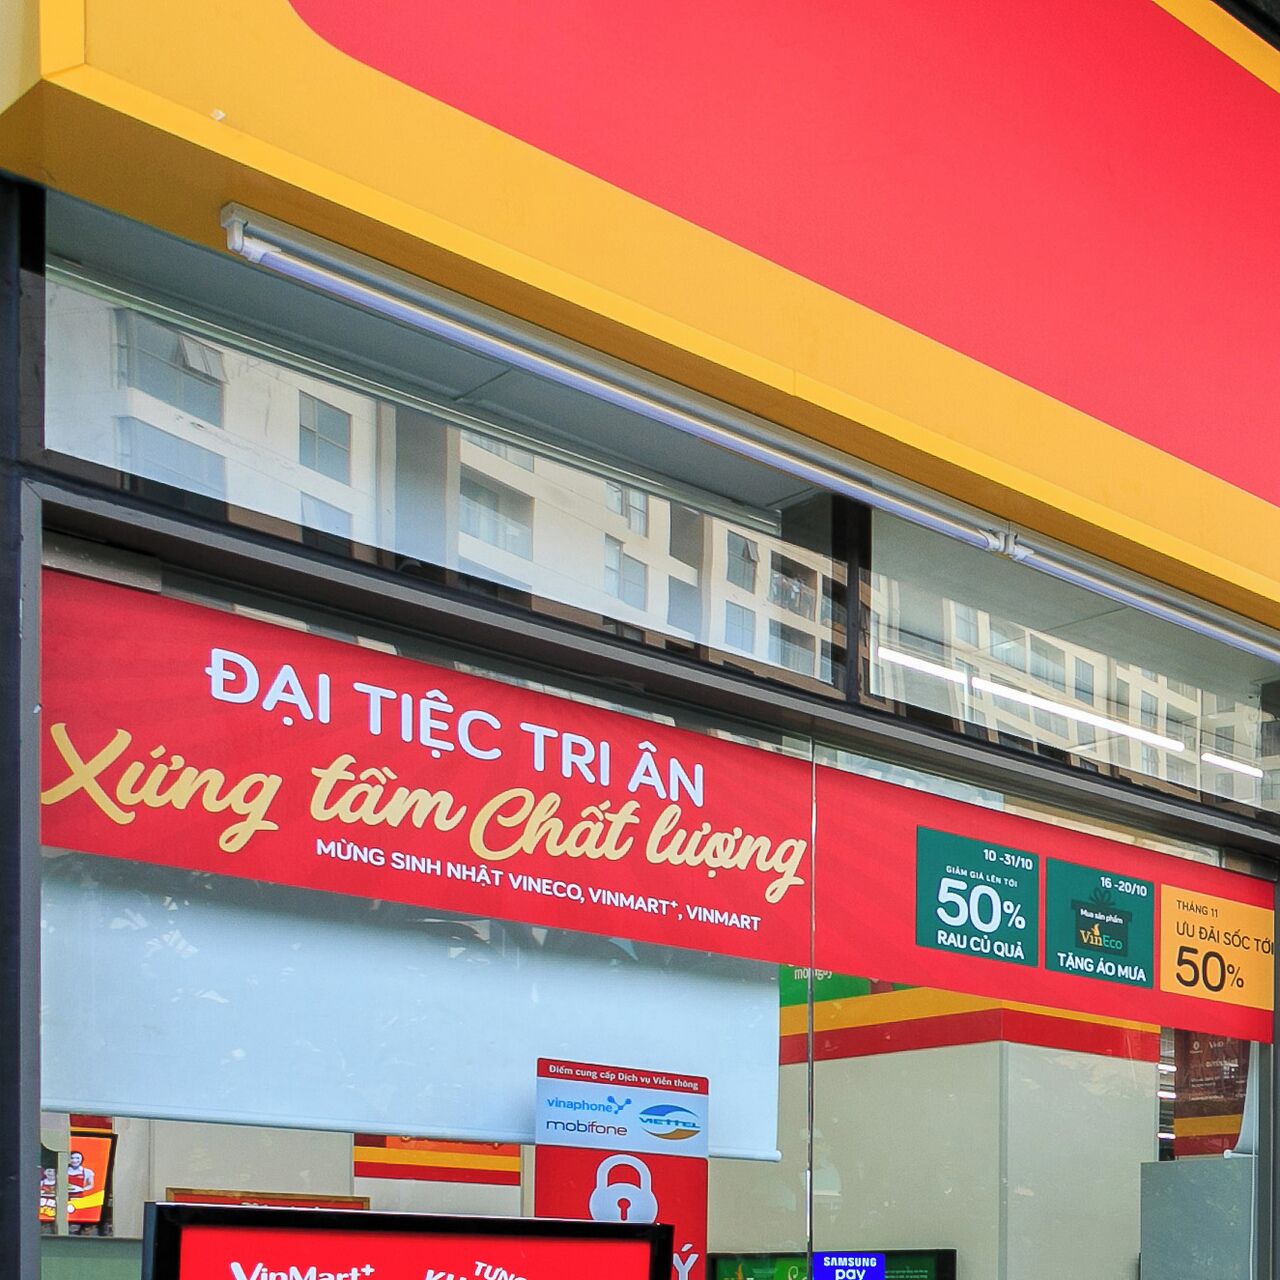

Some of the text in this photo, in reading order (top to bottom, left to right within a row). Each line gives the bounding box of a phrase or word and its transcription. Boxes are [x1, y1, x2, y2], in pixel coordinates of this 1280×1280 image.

[205, 648, 704, 808] ĐẠI TIỆC TRI ÂN
[41, 723, 807, 902] Xứng tầm Chất lượng
[984, 848, 996, 863] 10
[316, 839, 385, 869] MỪNG
[390, 853, 441, 877] SINH
[446, 860, 503, 891] NHẬT
[508, 870, 584, 903] VINECO,
[686, 906, 760, 932] VINMART
[970, 869, 985, 880] GIÁ
[986, 872, 1001, 884] LÊN
[1003, 876, 1018, 888] TỚI
[1100, 876, 1112, 889] 16
[936, 877, 1026, 933] 50%
[1080, 908, 1123, 925] Mua sản phẩm
[1176, 899, 1219, 918] THÁNG 11
[937, 930, 1024, 960] RAU CỦ QUẢ
[1079, 926, 1123, 950] VinEco
[1176, 921, 1274, 956] ƯU ĐÃI SỐC TỚI
[1057, 952, 1146, 982] TẶNG ÁO MƯA
[1175, 946, 1245, 993] 50%
[549, 1064, 699, 1090] Điểm cung cấp Dịch vụ Viễn thông
[547, 1097, 613, 1113] vinaphone
[546, 1119, 628, 1137] mobifone
[823, 1256, 877, 1267] SAMSUNG
